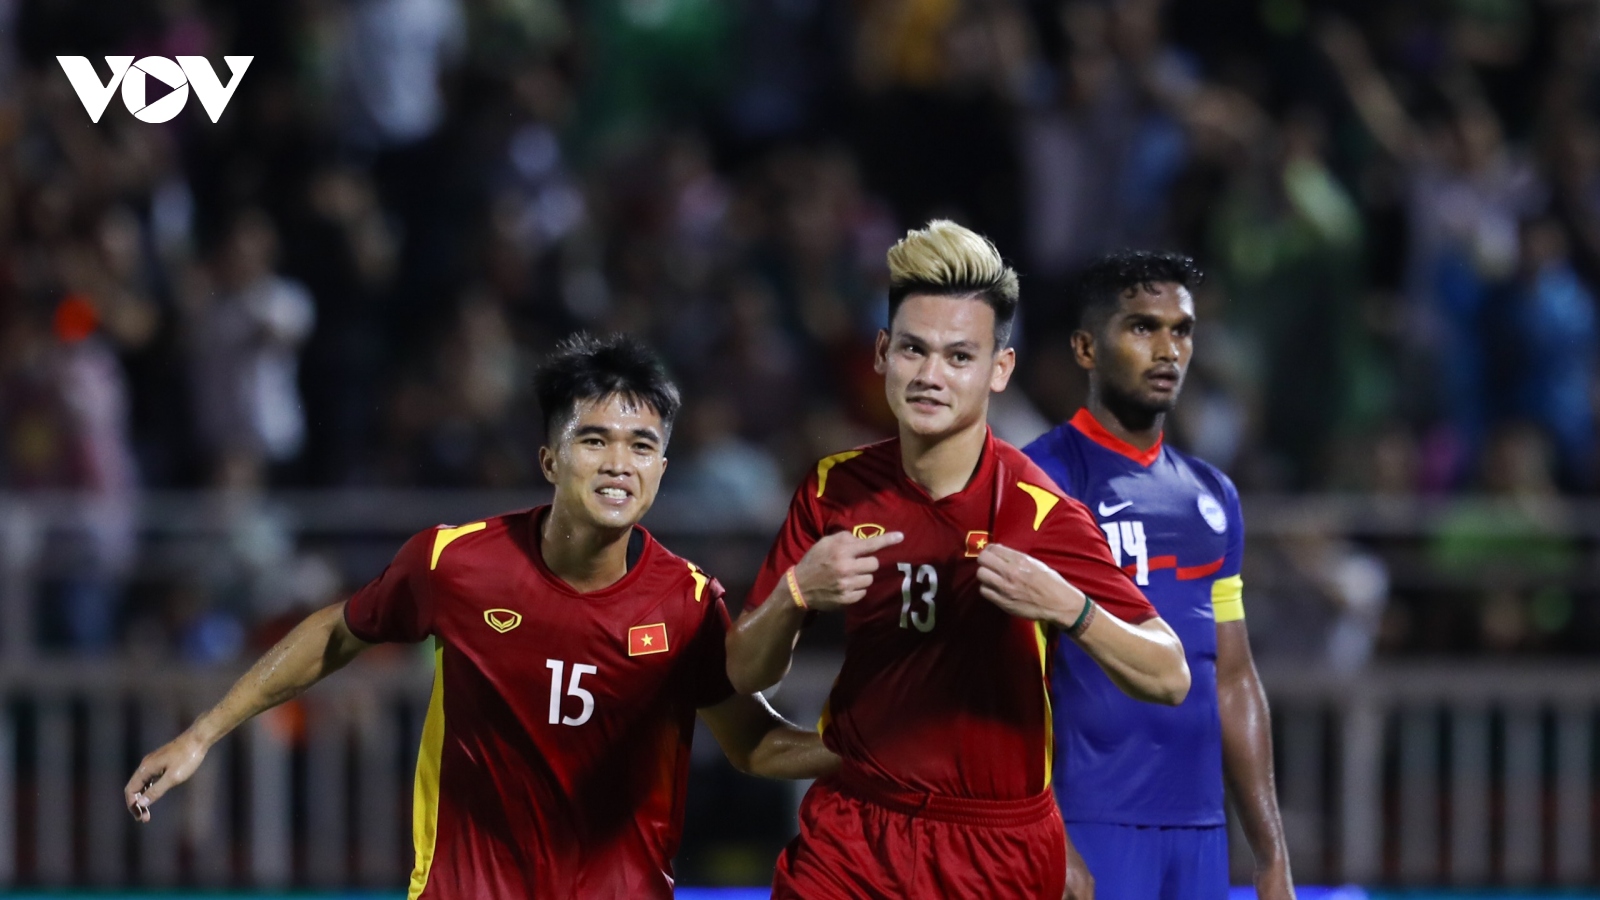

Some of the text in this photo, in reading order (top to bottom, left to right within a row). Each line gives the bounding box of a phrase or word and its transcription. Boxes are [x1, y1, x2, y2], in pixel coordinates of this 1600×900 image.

[1100, 521, 1149, 585] 14
[897, 562, 938, 633] 13
[546, 658, 598, 727] 15
